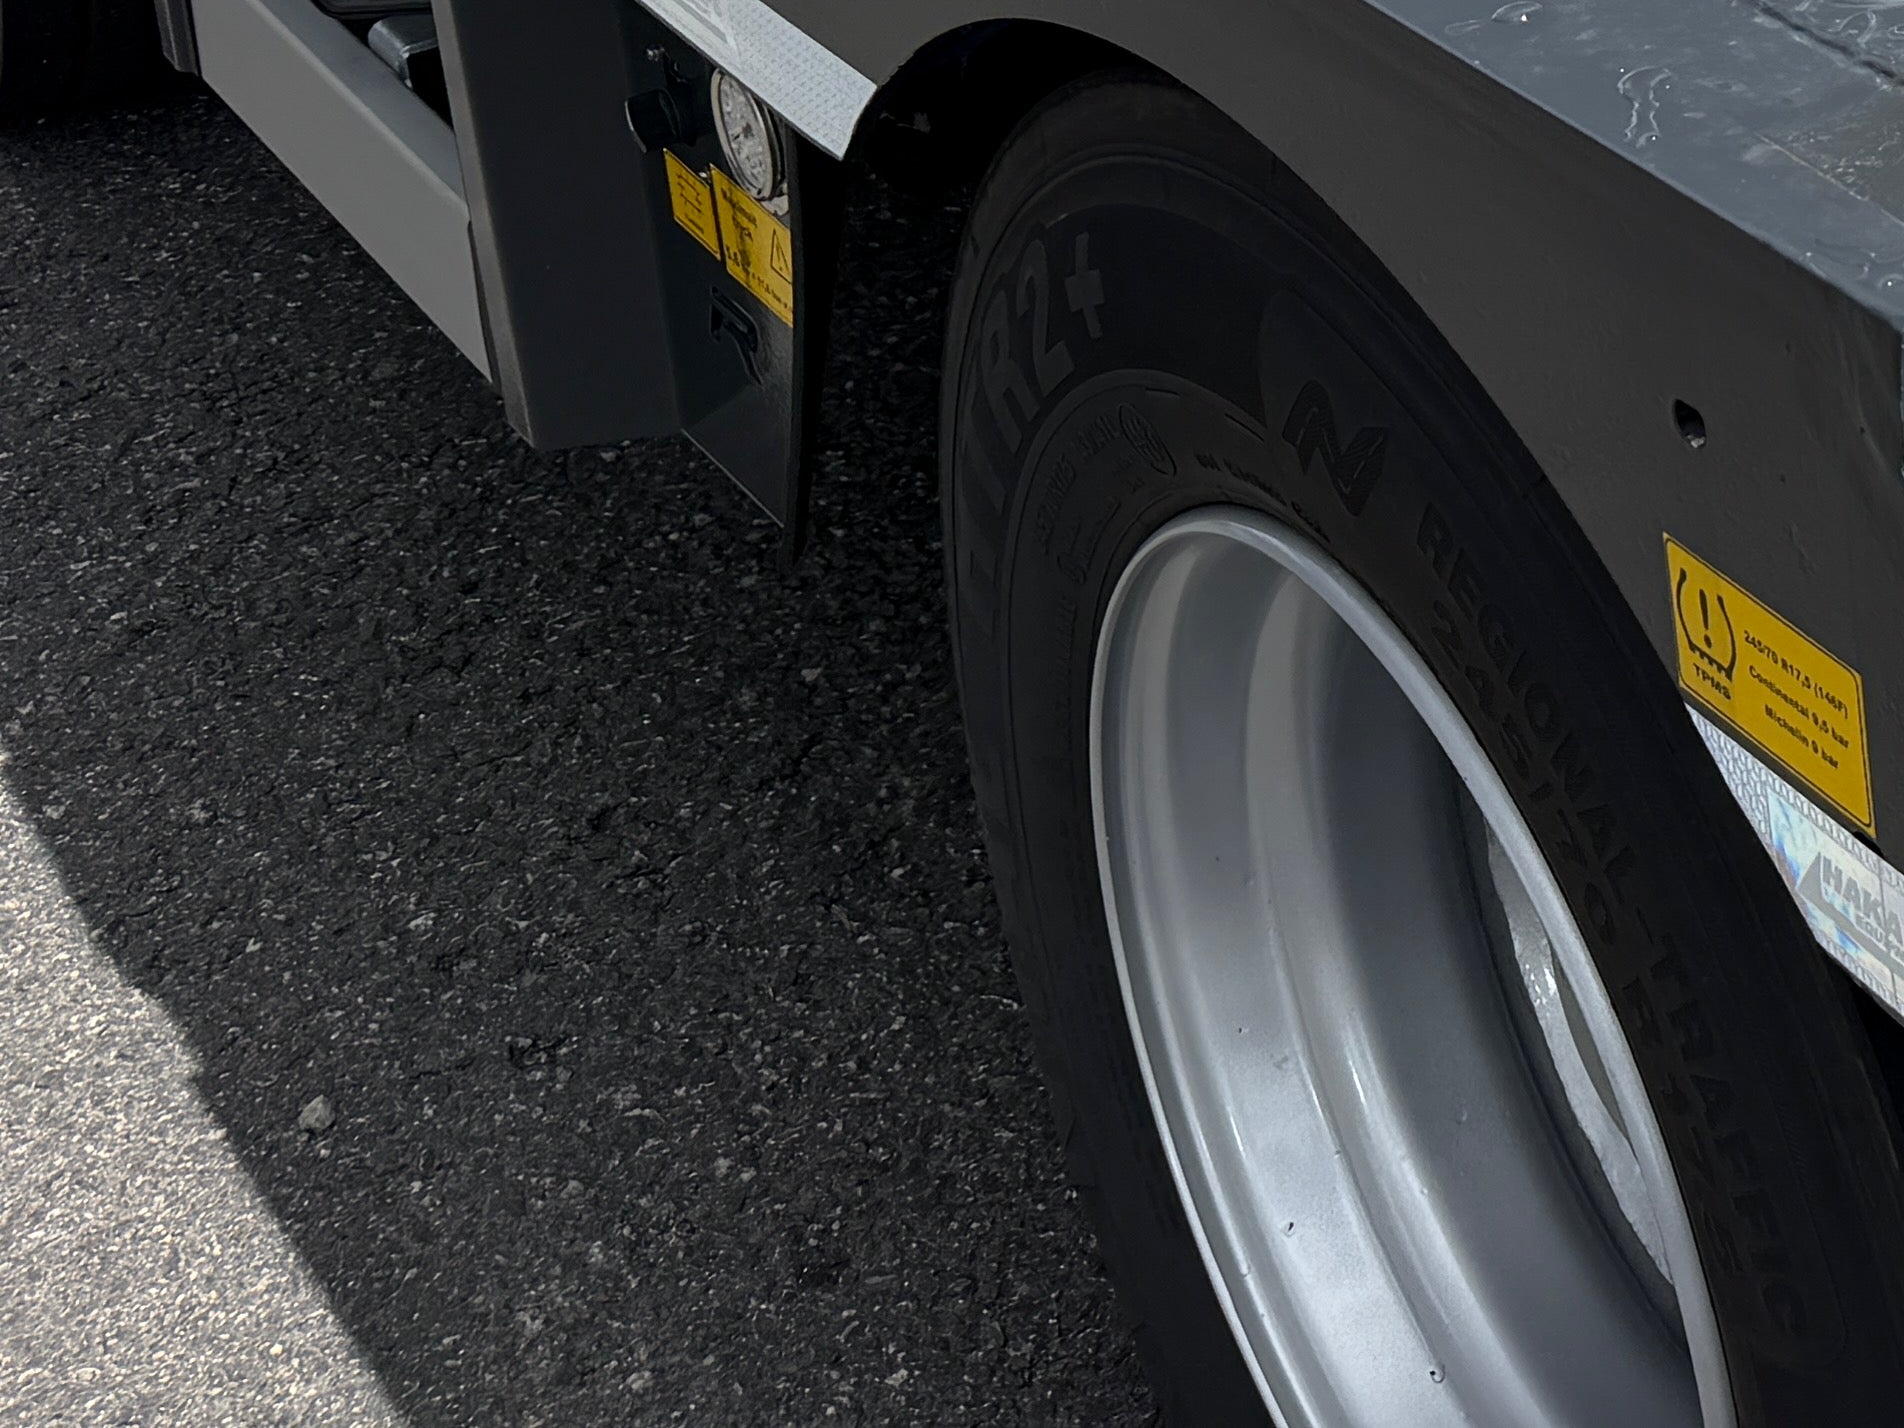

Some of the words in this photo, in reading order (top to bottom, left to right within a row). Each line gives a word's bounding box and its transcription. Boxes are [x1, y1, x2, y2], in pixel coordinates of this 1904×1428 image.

[1692, 665, 1732, 701] TPMS
[1749, 665, 1810, 720] Continental
[1764, 704, 1810, 746] Michelin
